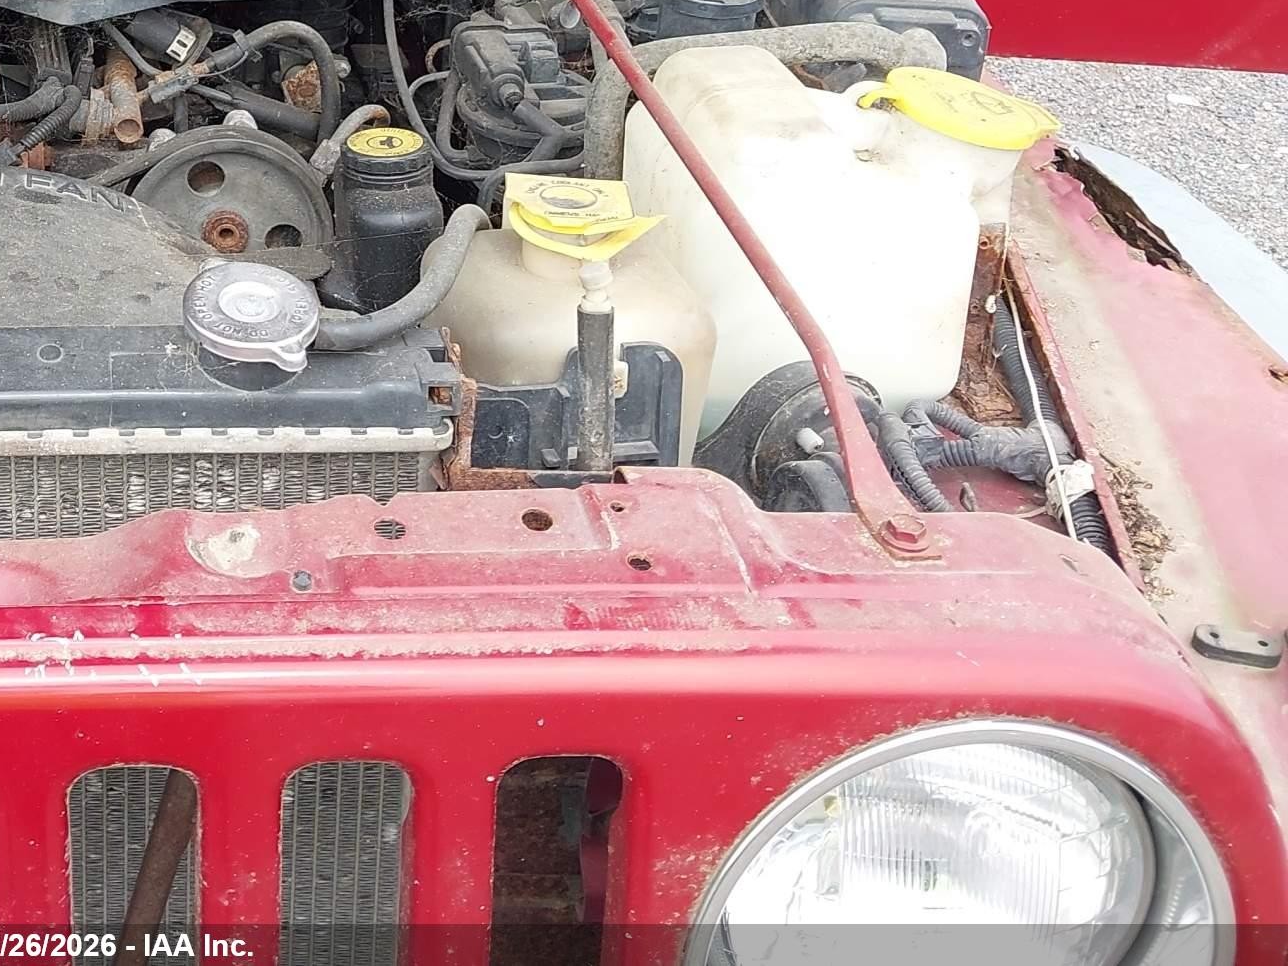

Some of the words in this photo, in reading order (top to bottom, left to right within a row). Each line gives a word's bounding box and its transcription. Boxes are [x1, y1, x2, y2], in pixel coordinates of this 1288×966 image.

[26, 173, 126, 213] FAN
[197, 275, 216, 291] HOT
[193, 295, 213, 321] OPEN
[214, 322, 242, 336] NOT
[249, 329, 269, 337] DO
